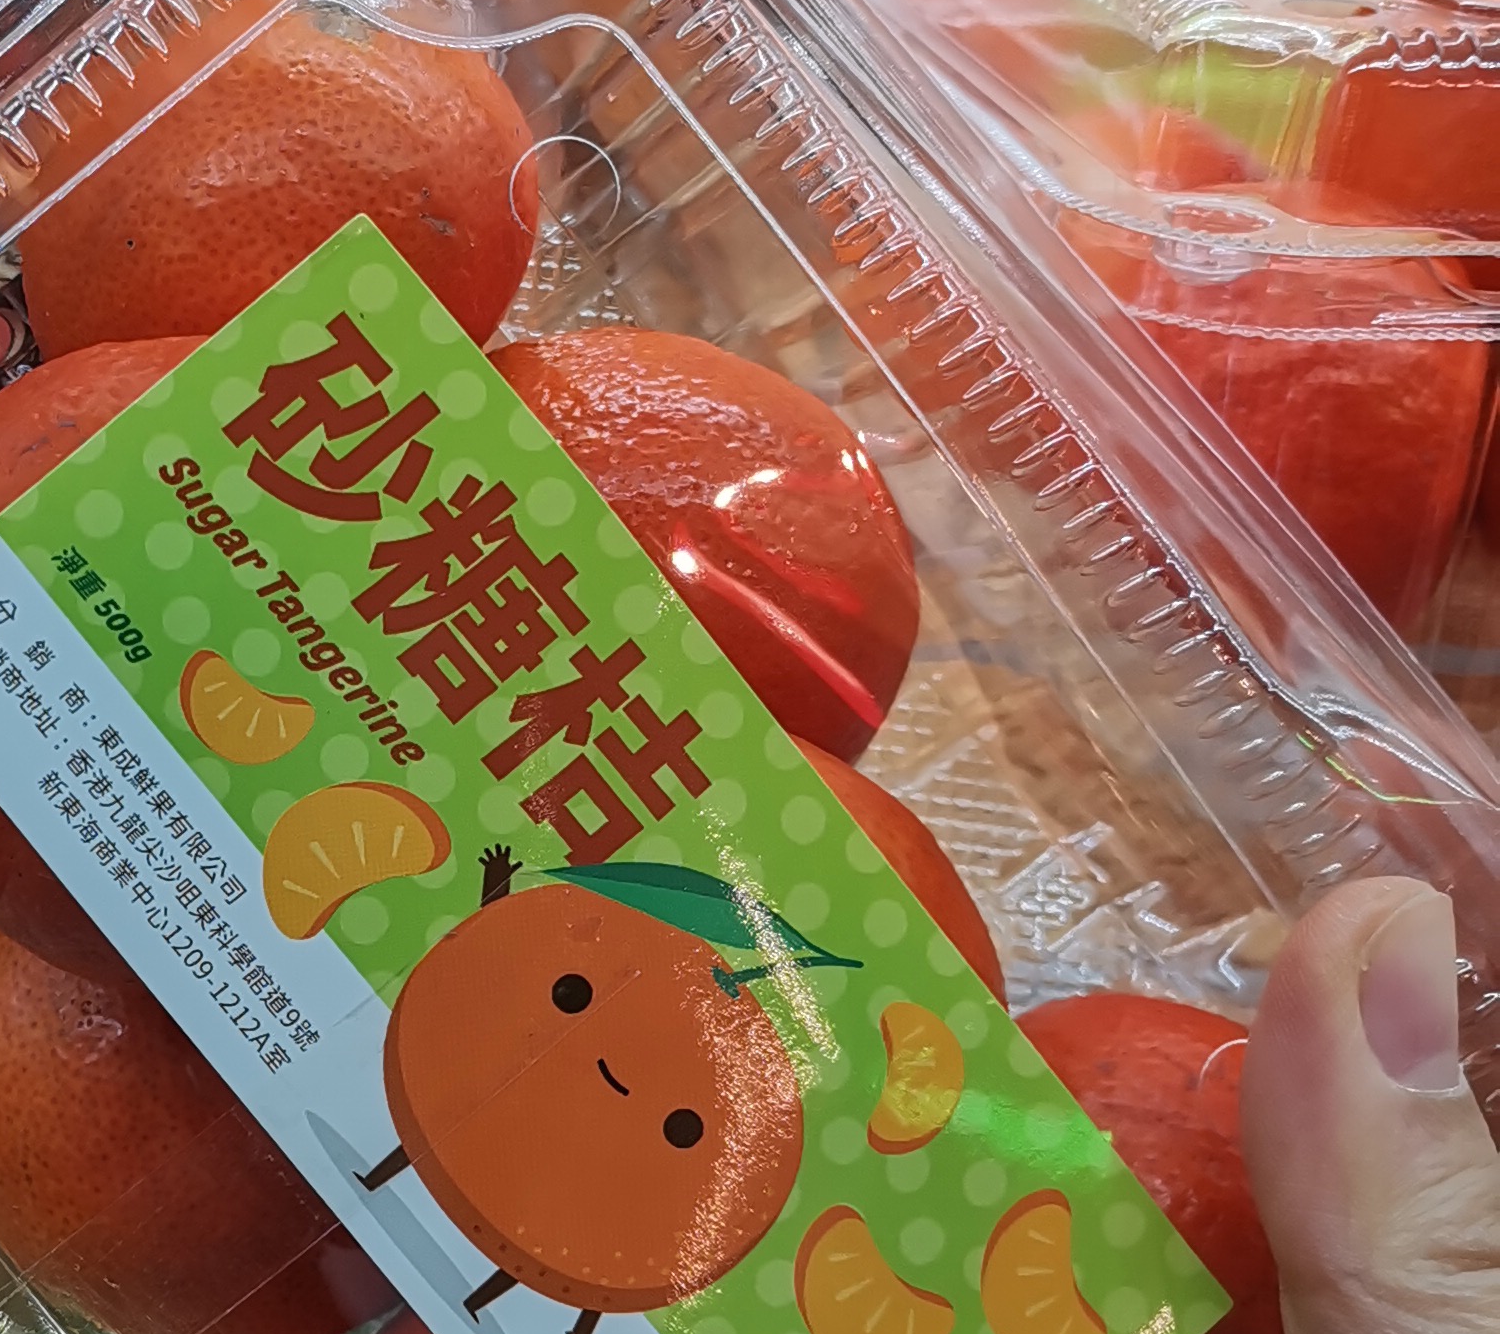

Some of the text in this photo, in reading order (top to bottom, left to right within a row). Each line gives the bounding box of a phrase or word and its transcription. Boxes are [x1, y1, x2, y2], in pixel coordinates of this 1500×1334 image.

[51, 545, 152, 664] 淨重 500g
[158, 455, 426, 768] Sugar Tangerine
[221, 310, 713, 867] 砂糖桔
